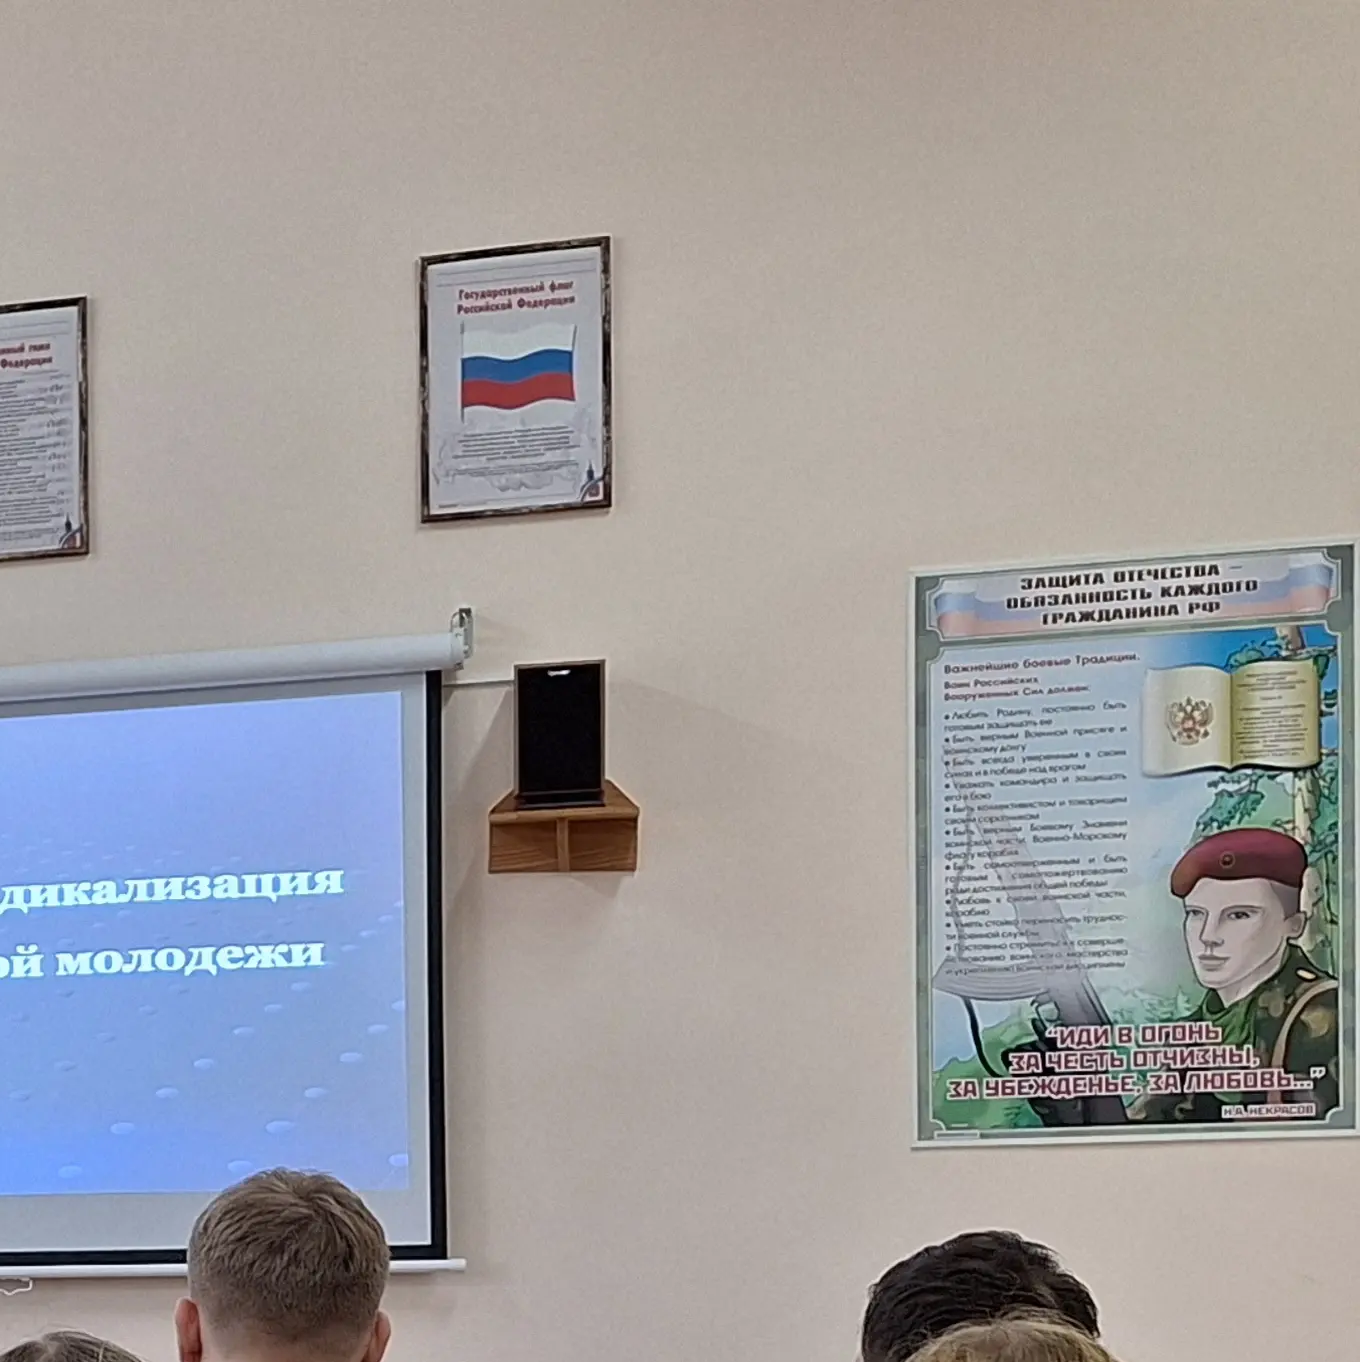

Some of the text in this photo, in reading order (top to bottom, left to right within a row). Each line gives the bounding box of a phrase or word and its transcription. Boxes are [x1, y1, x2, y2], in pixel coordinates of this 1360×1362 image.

[459, 280, 574, 300] Государственный флаг
[457, 296, 575, 314] Российской Федерации
[0, 356, 53, 369] Федерации
[1021, 563, 1220, 590] ЗАЩИТА ОТЕЧЕСТВА
[1006, 580, 1258, 609] ОБЯЗАННОСТЬ КАЖДОГО
[1042, 602, 1220, 625] ГРАЖДАНИНА РФ
[944, 662, 1019, 674] Важнейшие
[1023, 658, 1071, 669] боевые
[1023, 687, 1044, 696] Сил
[55, 942, 325, 976] молодежи
[1118, 1026, 1133, 1044] В
[1141, 1024, 1221, 1043] ОГОНЬ
[1010, 1046, 1260, 1072] ЗА ЧЕСТЬ ОТЧИЗНЫ,
[948, 1080, 977, 1098] ЗА
[985, 1076, 1143, 1099] УБЕЖДЕНЬЕ,
[1149, 1073, 1180, 1091] ЗА
[1250, 1105, 1314, 1116] НЕКРАСОВ
